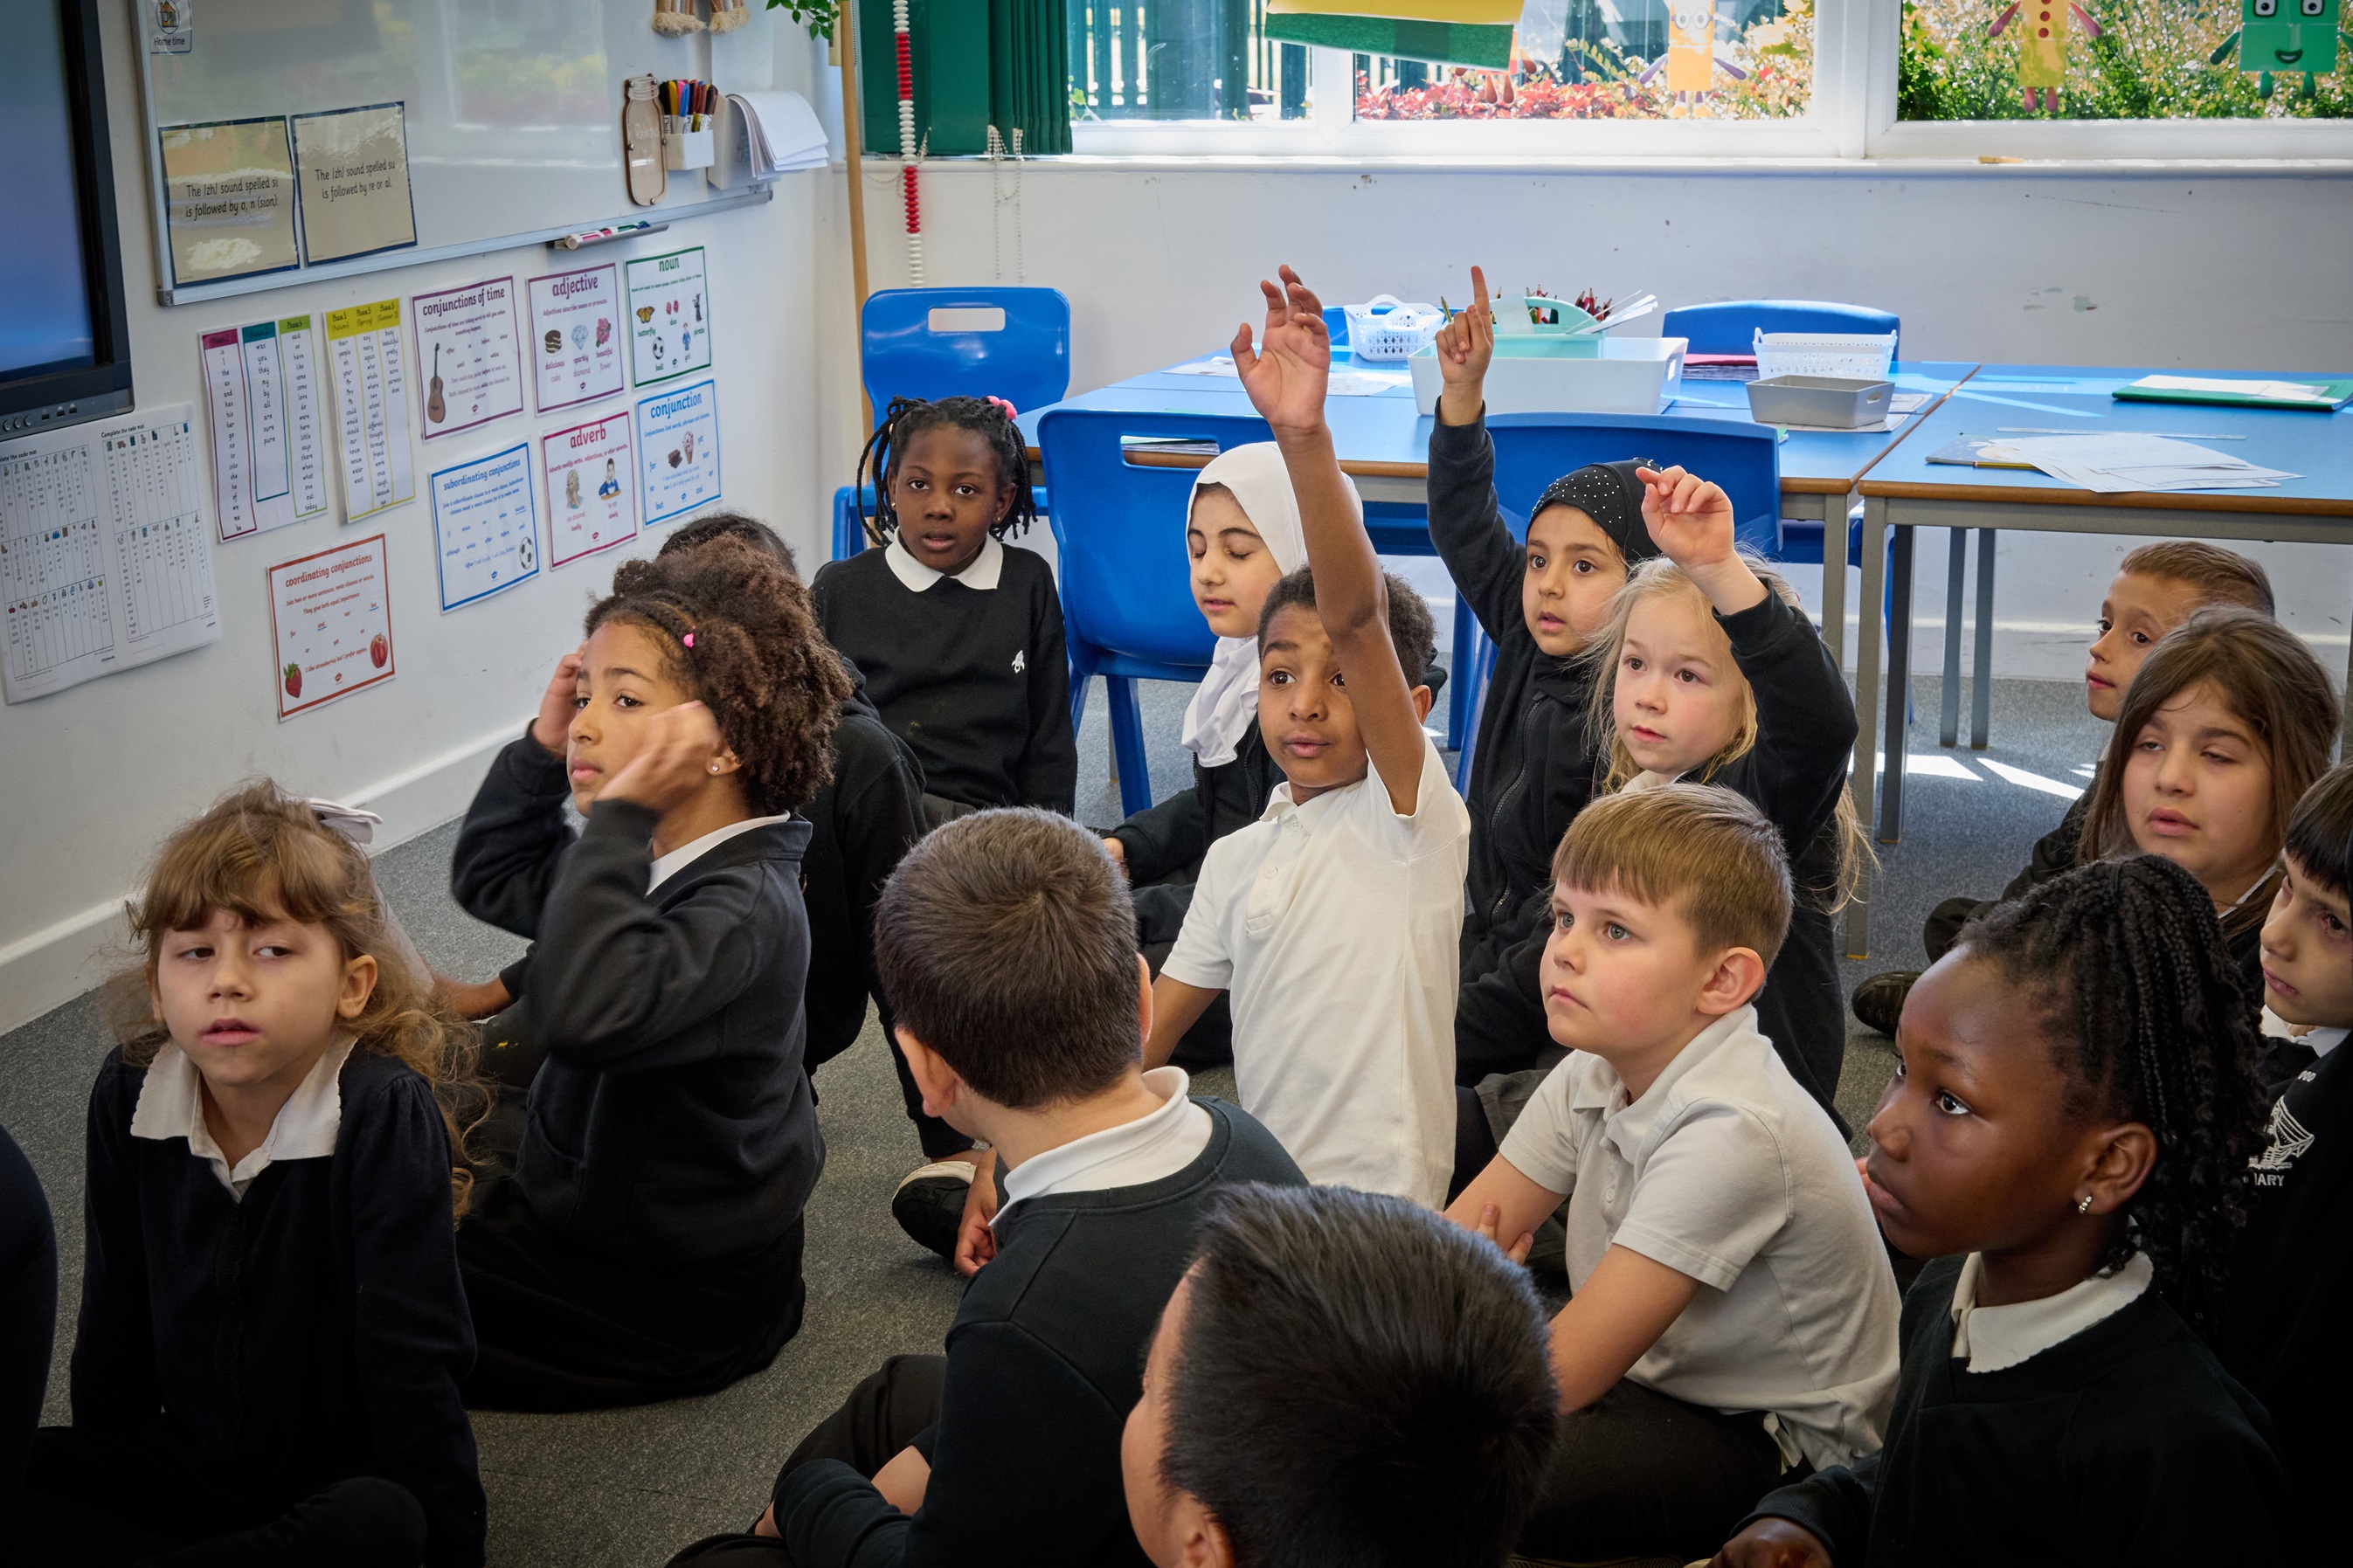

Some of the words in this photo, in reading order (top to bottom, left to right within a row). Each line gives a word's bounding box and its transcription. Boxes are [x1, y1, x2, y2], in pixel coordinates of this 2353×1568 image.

[154, 37, 171, 46] Home
[172, 36, 185, 45] time
[315, 169, 329, 181] The
[346, 162, 364, 177] sound
[366, 159, 386, 177] spelled
[388, 161, 396, 169] su
[186, 184, 201, 197] The
[220, 179, 243, 193] sound
[245, 176, 270, 195] spelled
[272, 177, 279, 188] si
[322, 188, 329, 199] is
[330, 182, 358, 203] followed
[359, 181, 367, 197] by
[369, 182, 375, 191] re
[377, 180, 383, 190] or
[186, 206, 192, 218] is
[193, 200, 227, 222] followed
[229, 199, 239, 216] by
[241, 202, 248, 211] o,
[659, 257, 680, 273] noun
[552, 273, 599, 300] adjective
[423, 294, 477, 317] conjunctions
[478, 288, 485, 307] of
[487, 287, 505, 301] time
[258, 356, 267, 365] you
[224, 389, 233, 397] and
[263, 390, 270, 399] by
[650, 391, 702, 419] conjunction
[101, 429, 121, 439] Complete
[264, 437, 275, 446] pure
[570, 422, 606, 448] adverb
[443, 471, 488, 491] subordinating
[488, 459, 521, 476] conjunctions
[286, 567, 329, 588] coordinating
[331, 554, 372, 573] conjunctions
